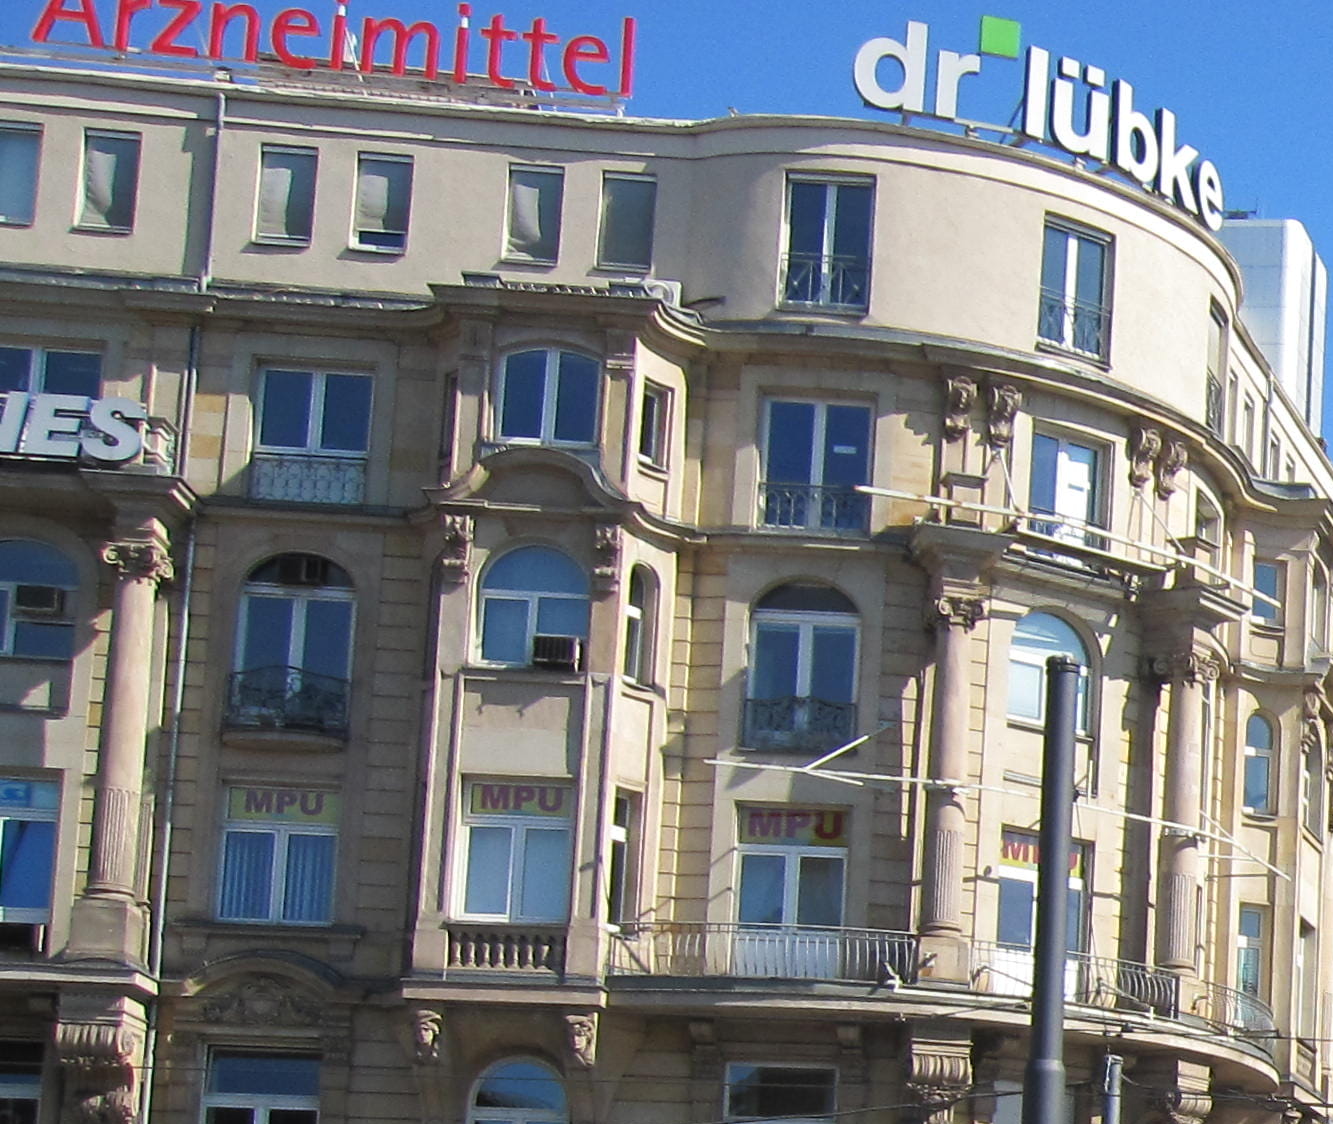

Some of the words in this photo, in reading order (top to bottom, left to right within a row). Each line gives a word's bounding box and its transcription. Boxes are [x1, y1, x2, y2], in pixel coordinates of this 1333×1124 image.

[32, 0, 637, 97] Arzneimittel
[853, 20, 980, 119] dr
[1023, 45, 1224, 231] lübke
[244, 789, 324, 816] MPU
[479, 784, 563, 813] MPU
[748, 809, 843, 840] MPU
